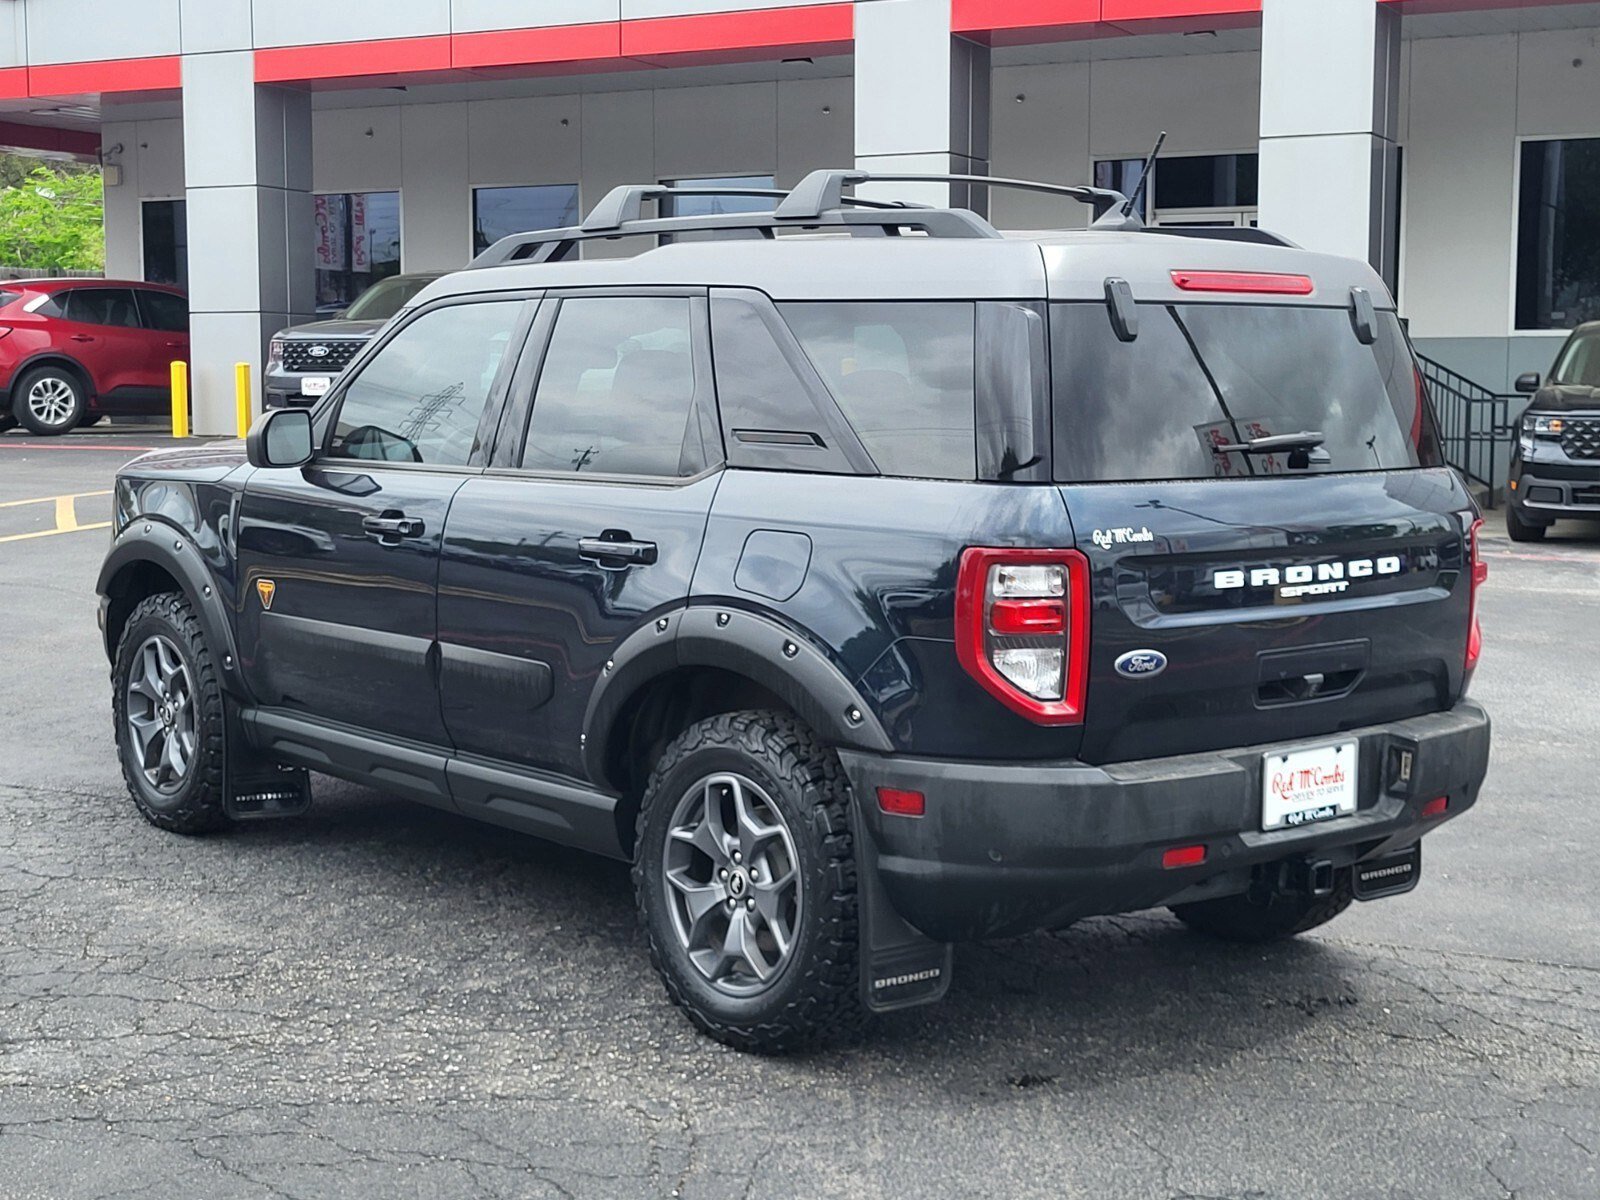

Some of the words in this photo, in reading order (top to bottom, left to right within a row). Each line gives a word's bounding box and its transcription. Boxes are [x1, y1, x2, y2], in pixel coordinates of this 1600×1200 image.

[1092, 529, 1113, 550] Red
[1213, 556, 1400, 589] BRONCO
[1280, 581, 1350, 598] SPORT
[1272, 771, 1293, 800] Red
[1360, 863, 1412, 881] BRONCO
[873, 967, 940, 989] BRONCO
